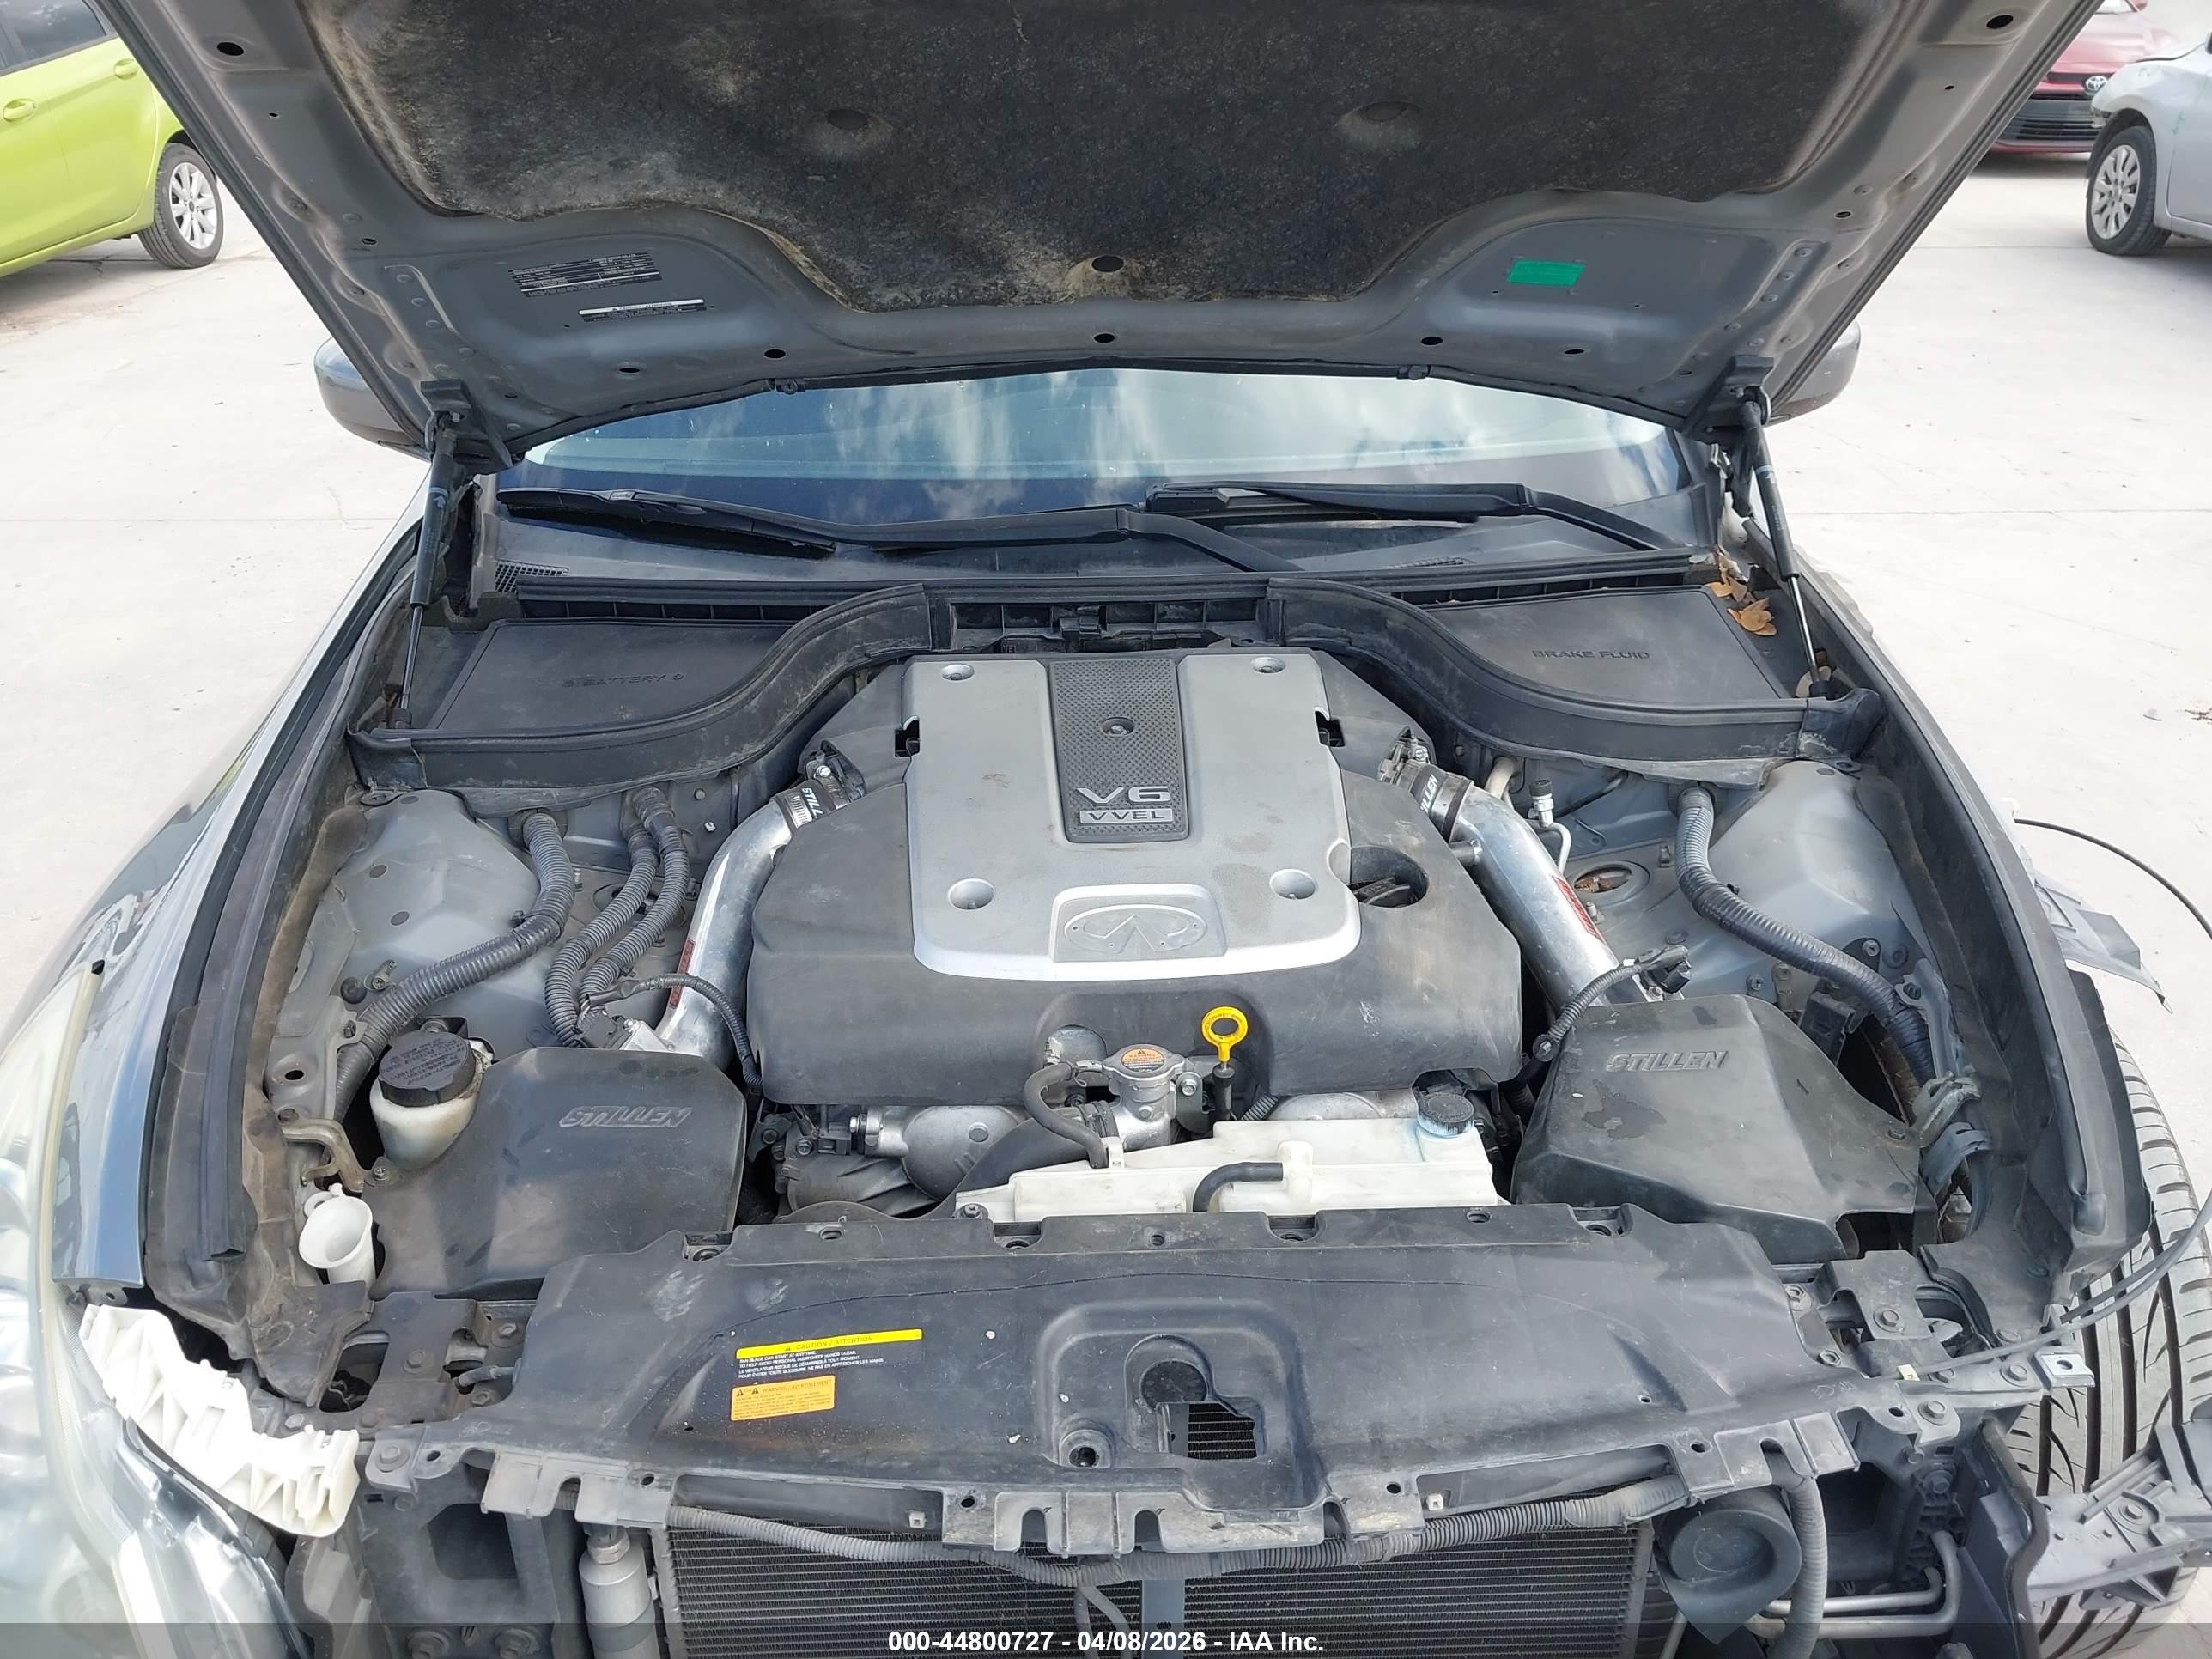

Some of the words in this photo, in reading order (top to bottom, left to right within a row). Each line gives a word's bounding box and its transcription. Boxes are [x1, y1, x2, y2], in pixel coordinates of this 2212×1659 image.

[1532, 650, 1595, 659] BRAKE
[1598, 651, 1650, 659] FLUID
[583, 674, 667, 687] BATTERY
[1076, 786, 1171, 805] V6
[1088, 811, 1165, 820] VVEL
[1606, 1051, 1729, 1072] STILLEN
[558, 1106, 693, 1127] STILLEN
[796, 1341, 828, 1350] CAUTION
[835, 1336, 873, 1345] ATTENTION
